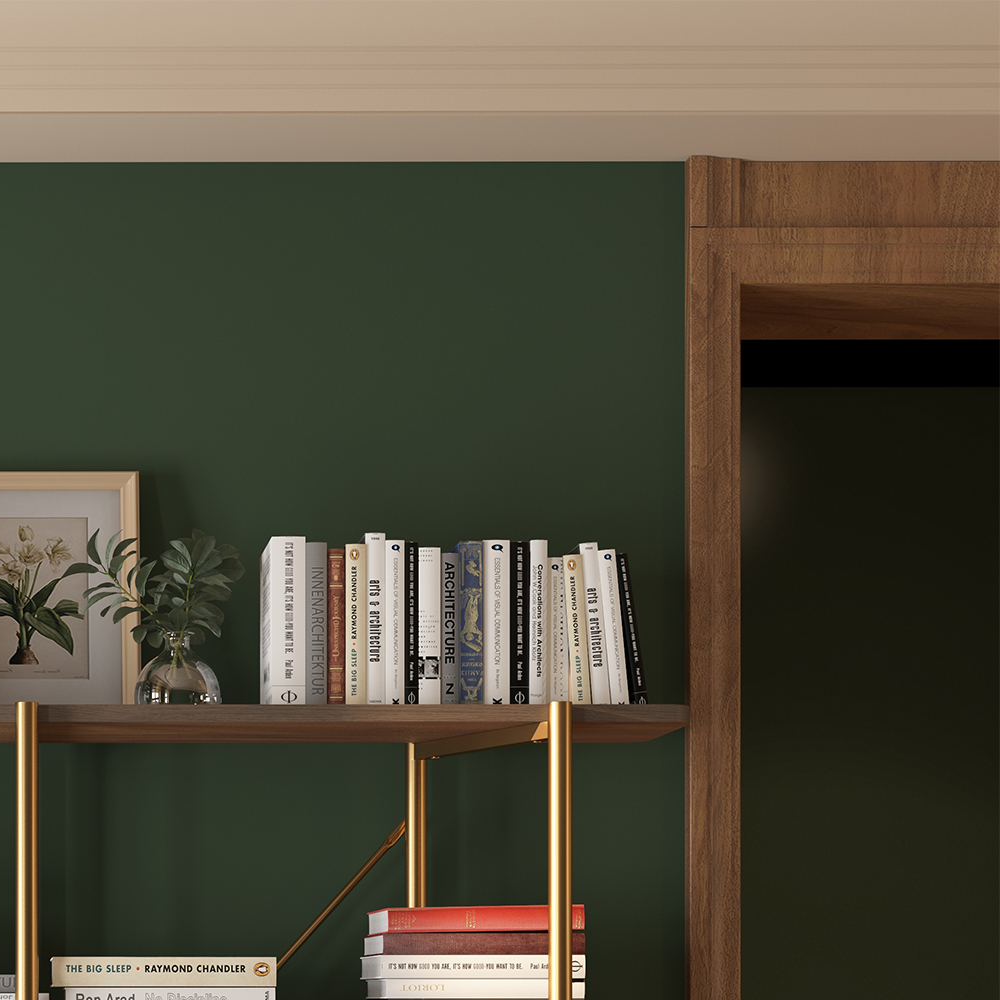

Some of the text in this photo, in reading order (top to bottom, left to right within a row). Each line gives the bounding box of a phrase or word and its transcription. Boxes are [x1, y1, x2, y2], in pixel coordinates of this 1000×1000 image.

[368, 579, 381, 596] arts
[569, 575, 577, 610] CHANDLER
[586, 587, 598, 604] arts
[310, 566, 325, 696] INNENARCHITEKTUR
[444, 561, 455, 664] ARCHITECTURE
[368, 610, 382, 662] architecture
[588, 617, 603, 667] architecture
[65, 964, 245, 973] THE BIG SLEEP RAYMOND CHANDLER
